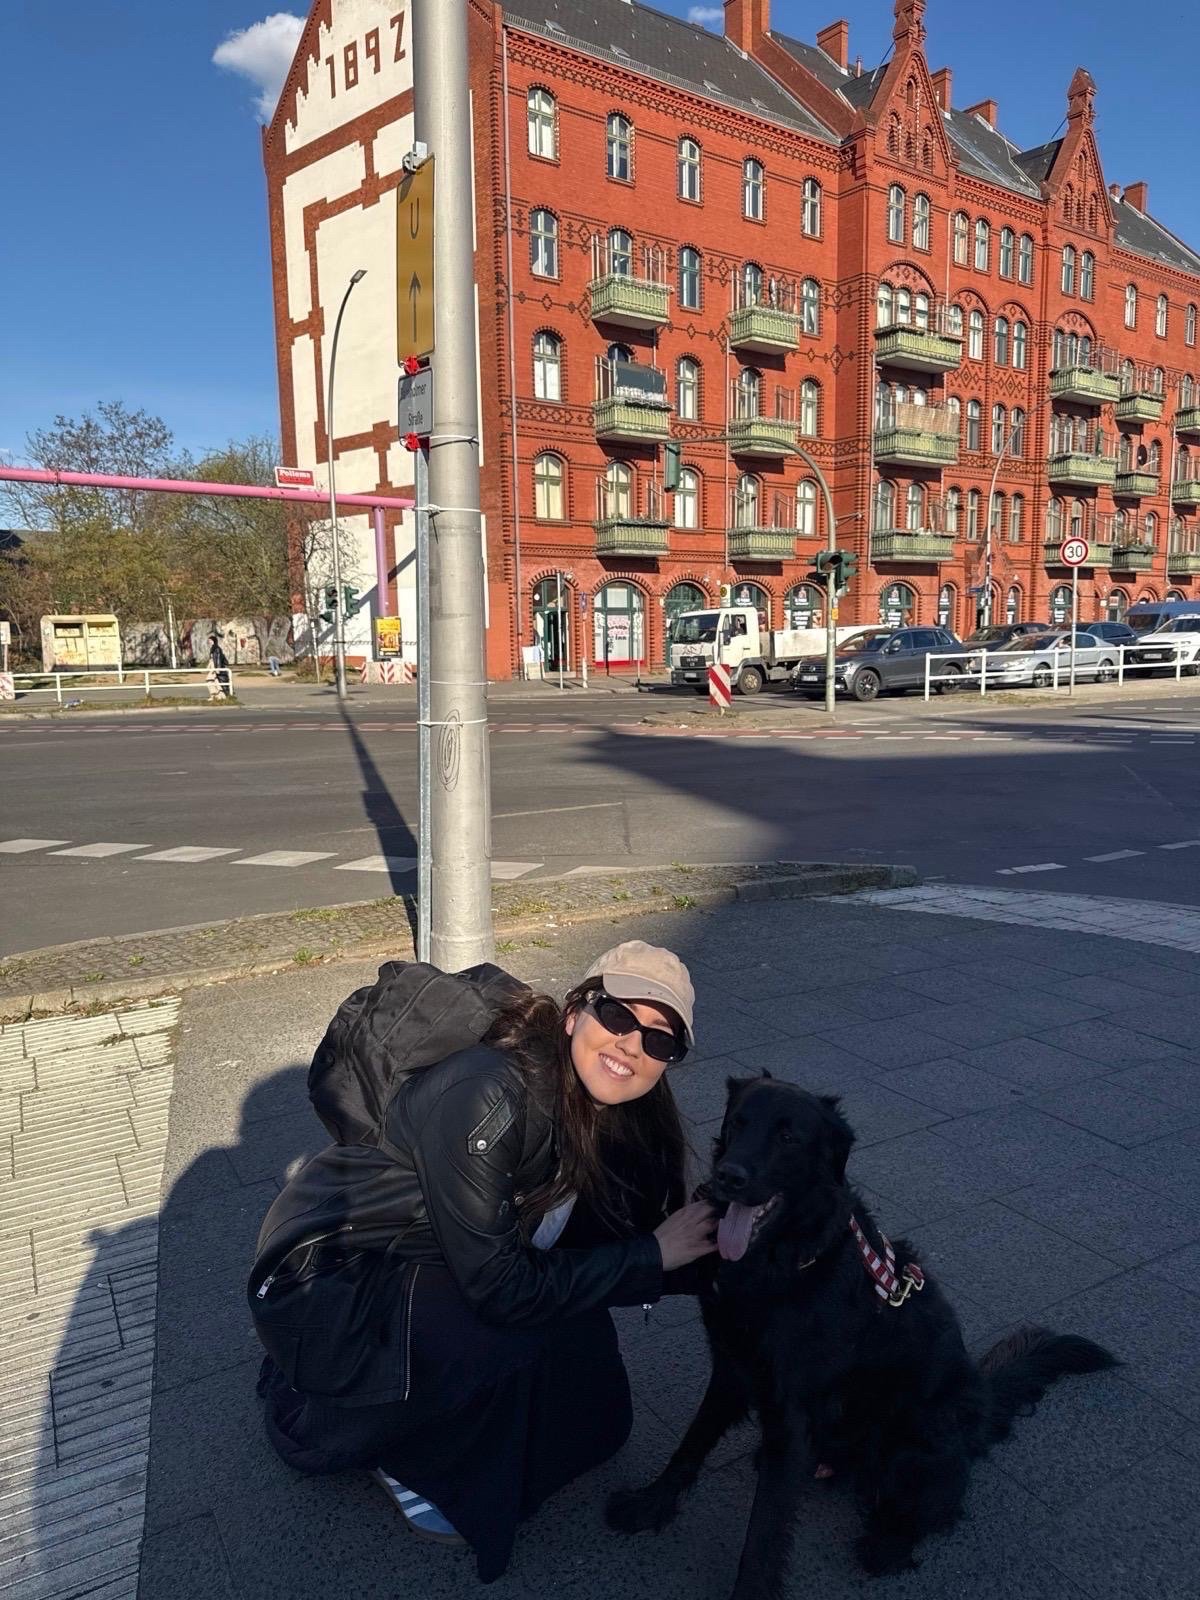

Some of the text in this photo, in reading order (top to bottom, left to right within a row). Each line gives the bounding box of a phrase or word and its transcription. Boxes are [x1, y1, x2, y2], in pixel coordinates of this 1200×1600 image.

[326, 11, 406, 99] 1892
[410, 197, 420, 240] U
[1067, 545, 1083, 558] 30
